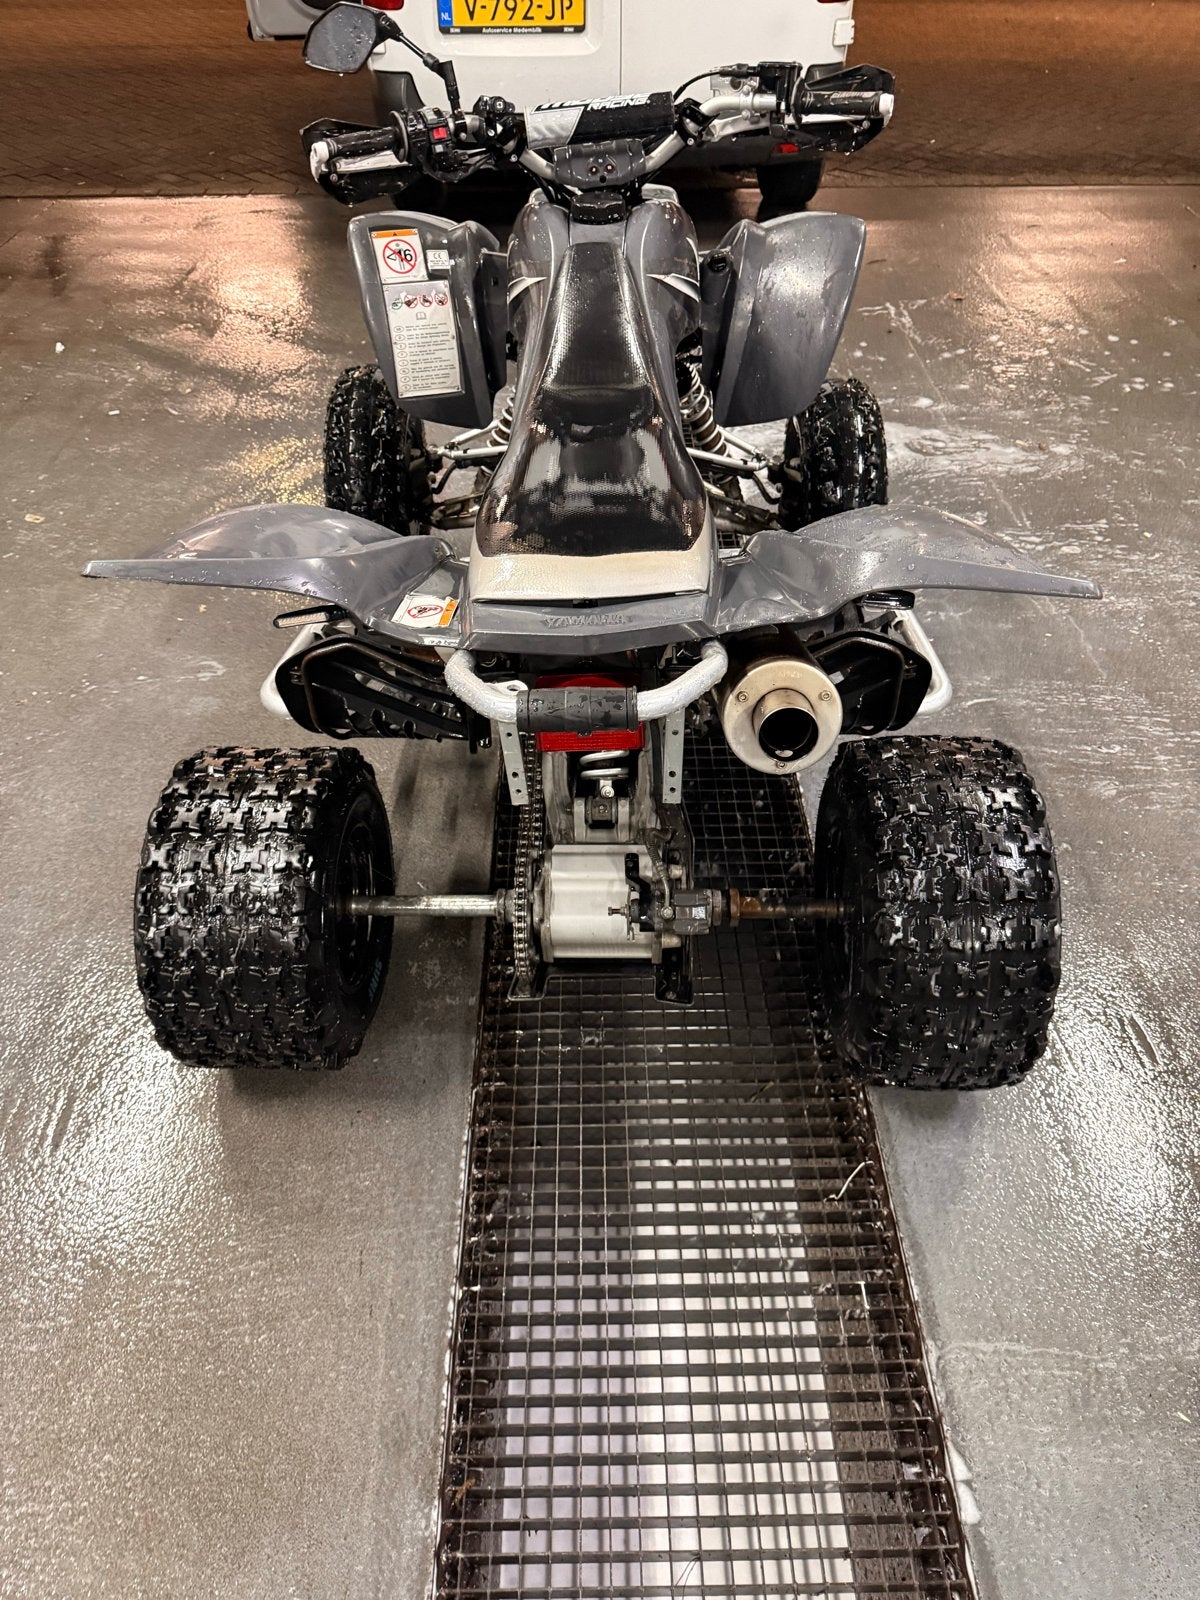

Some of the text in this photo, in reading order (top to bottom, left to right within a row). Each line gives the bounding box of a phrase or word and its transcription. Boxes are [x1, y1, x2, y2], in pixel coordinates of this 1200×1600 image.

[441, 12, 451, 21] NL
[464, 0, 574, 21] V-792-JP
[545, 613, 626, 629] YAMAHA
